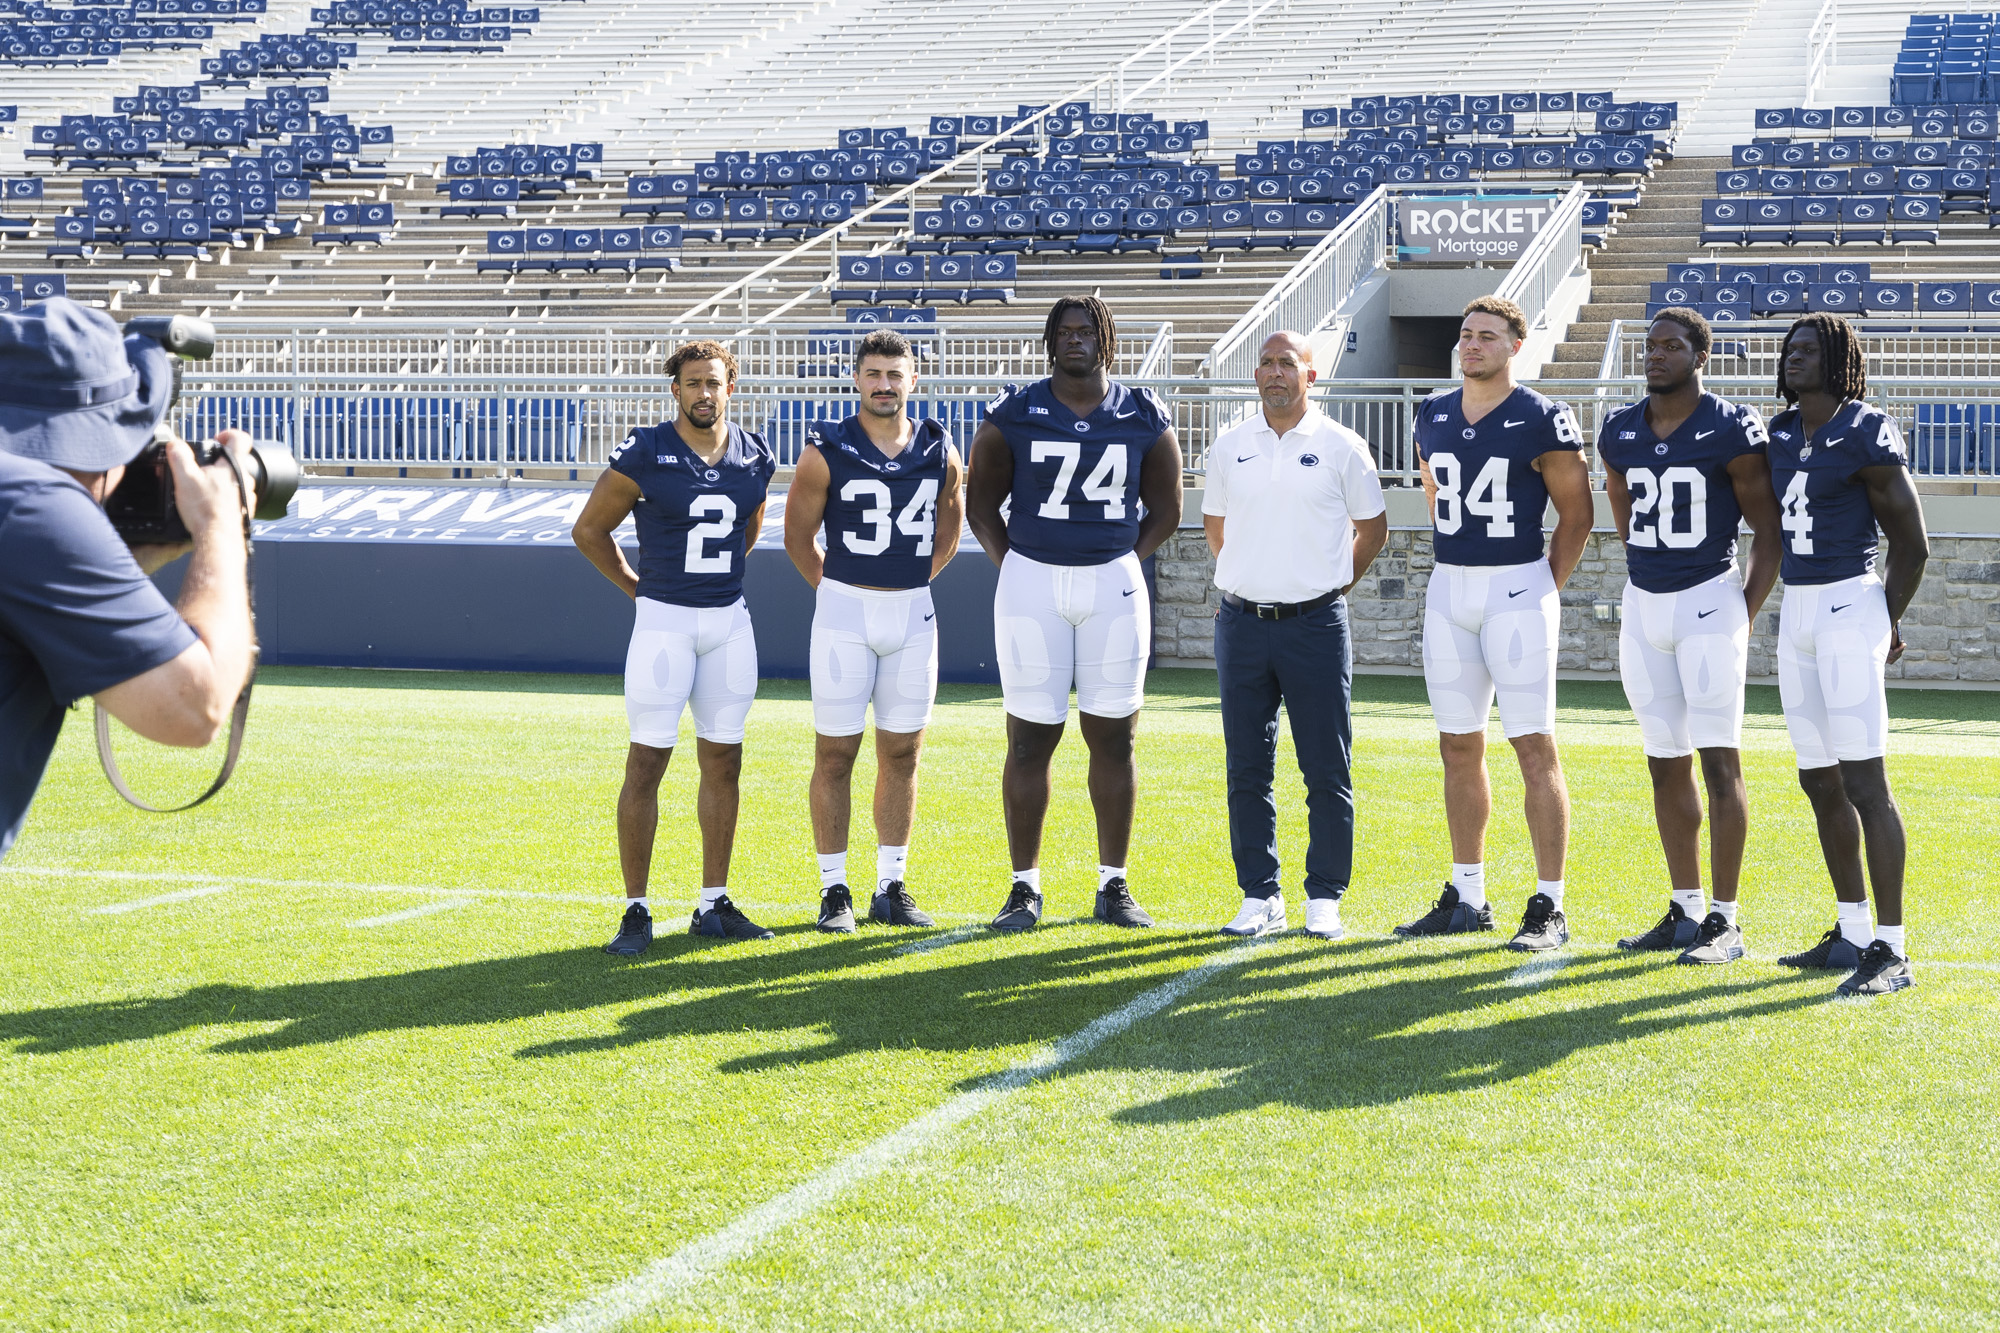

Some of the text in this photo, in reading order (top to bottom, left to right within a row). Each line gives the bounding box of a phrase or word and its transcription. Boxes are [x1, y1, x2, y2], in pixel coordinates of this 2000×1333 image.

[1410, 207, 1546, 235] ROCKET
[1438, 238, 1518, 256] Mortgage
[609, 435, 636, 461] 2
[1741, 414, 1769, 447] 2
[287, 488, 592, 524] NRIVA
[1030, 440, 1127, 520] 74
[1428, 452, 1515, 538] 84
[1625, 467, 1707, 549] 20
[308, 526, 467, 541] STATE
[684, 494, 737, 573] 2
[840, 479, 938, 557] 34
[1781, 471, 1814, 555] 4
